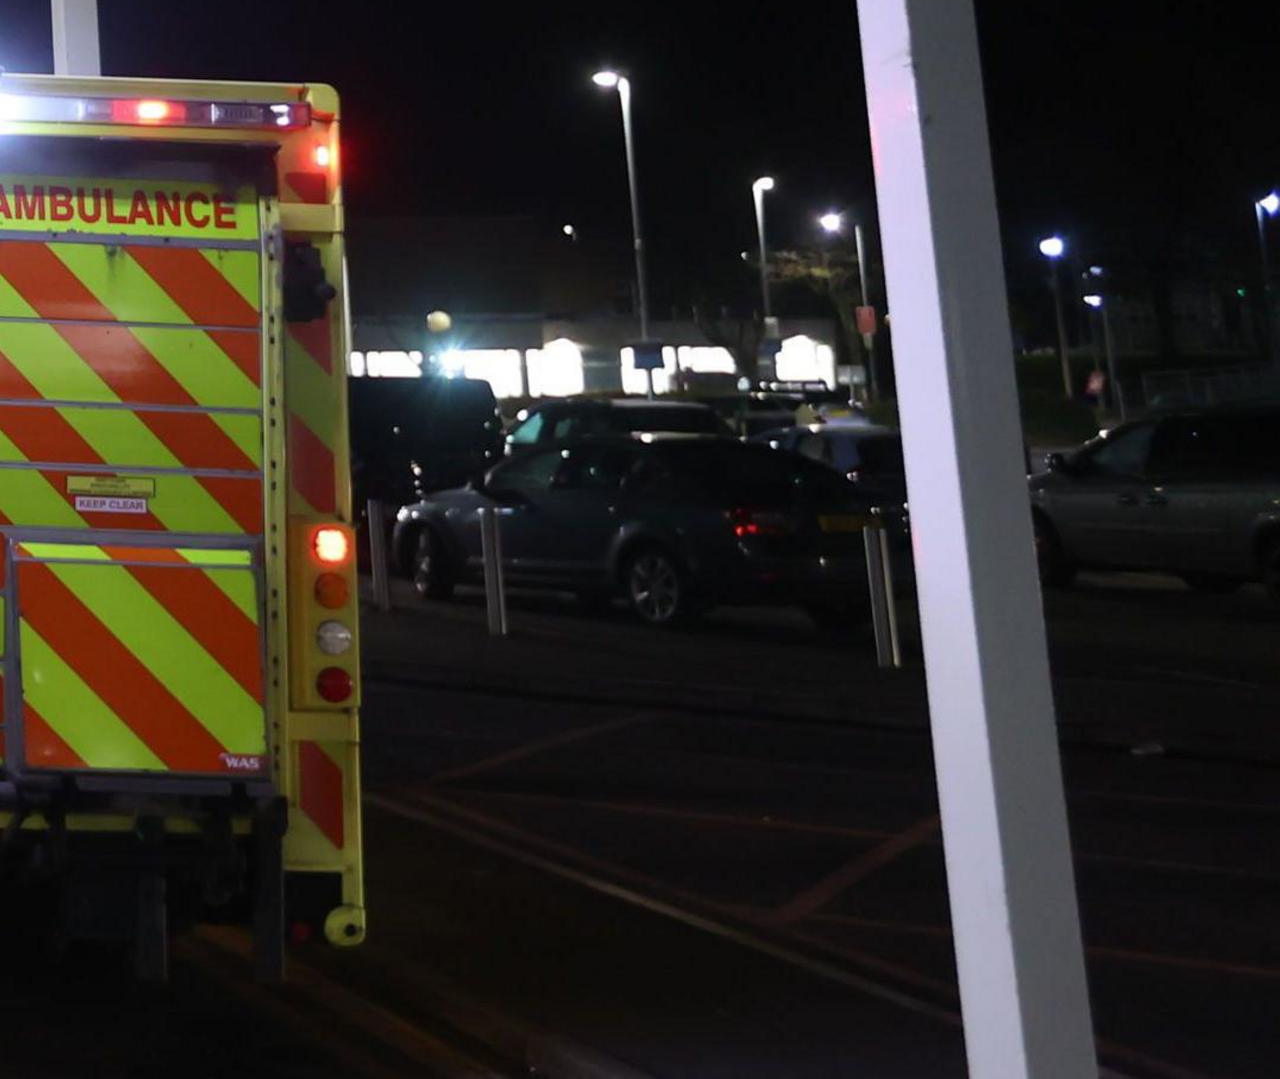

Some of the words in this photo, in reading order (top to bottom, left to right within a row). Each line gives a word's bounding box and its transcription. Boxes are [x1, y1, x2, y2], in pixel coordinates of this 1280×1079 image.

[79, 499, 106, 508] KEEP
[108, 500, 144, 510] CLEAR
[225, 757, 259, 769] WAS
